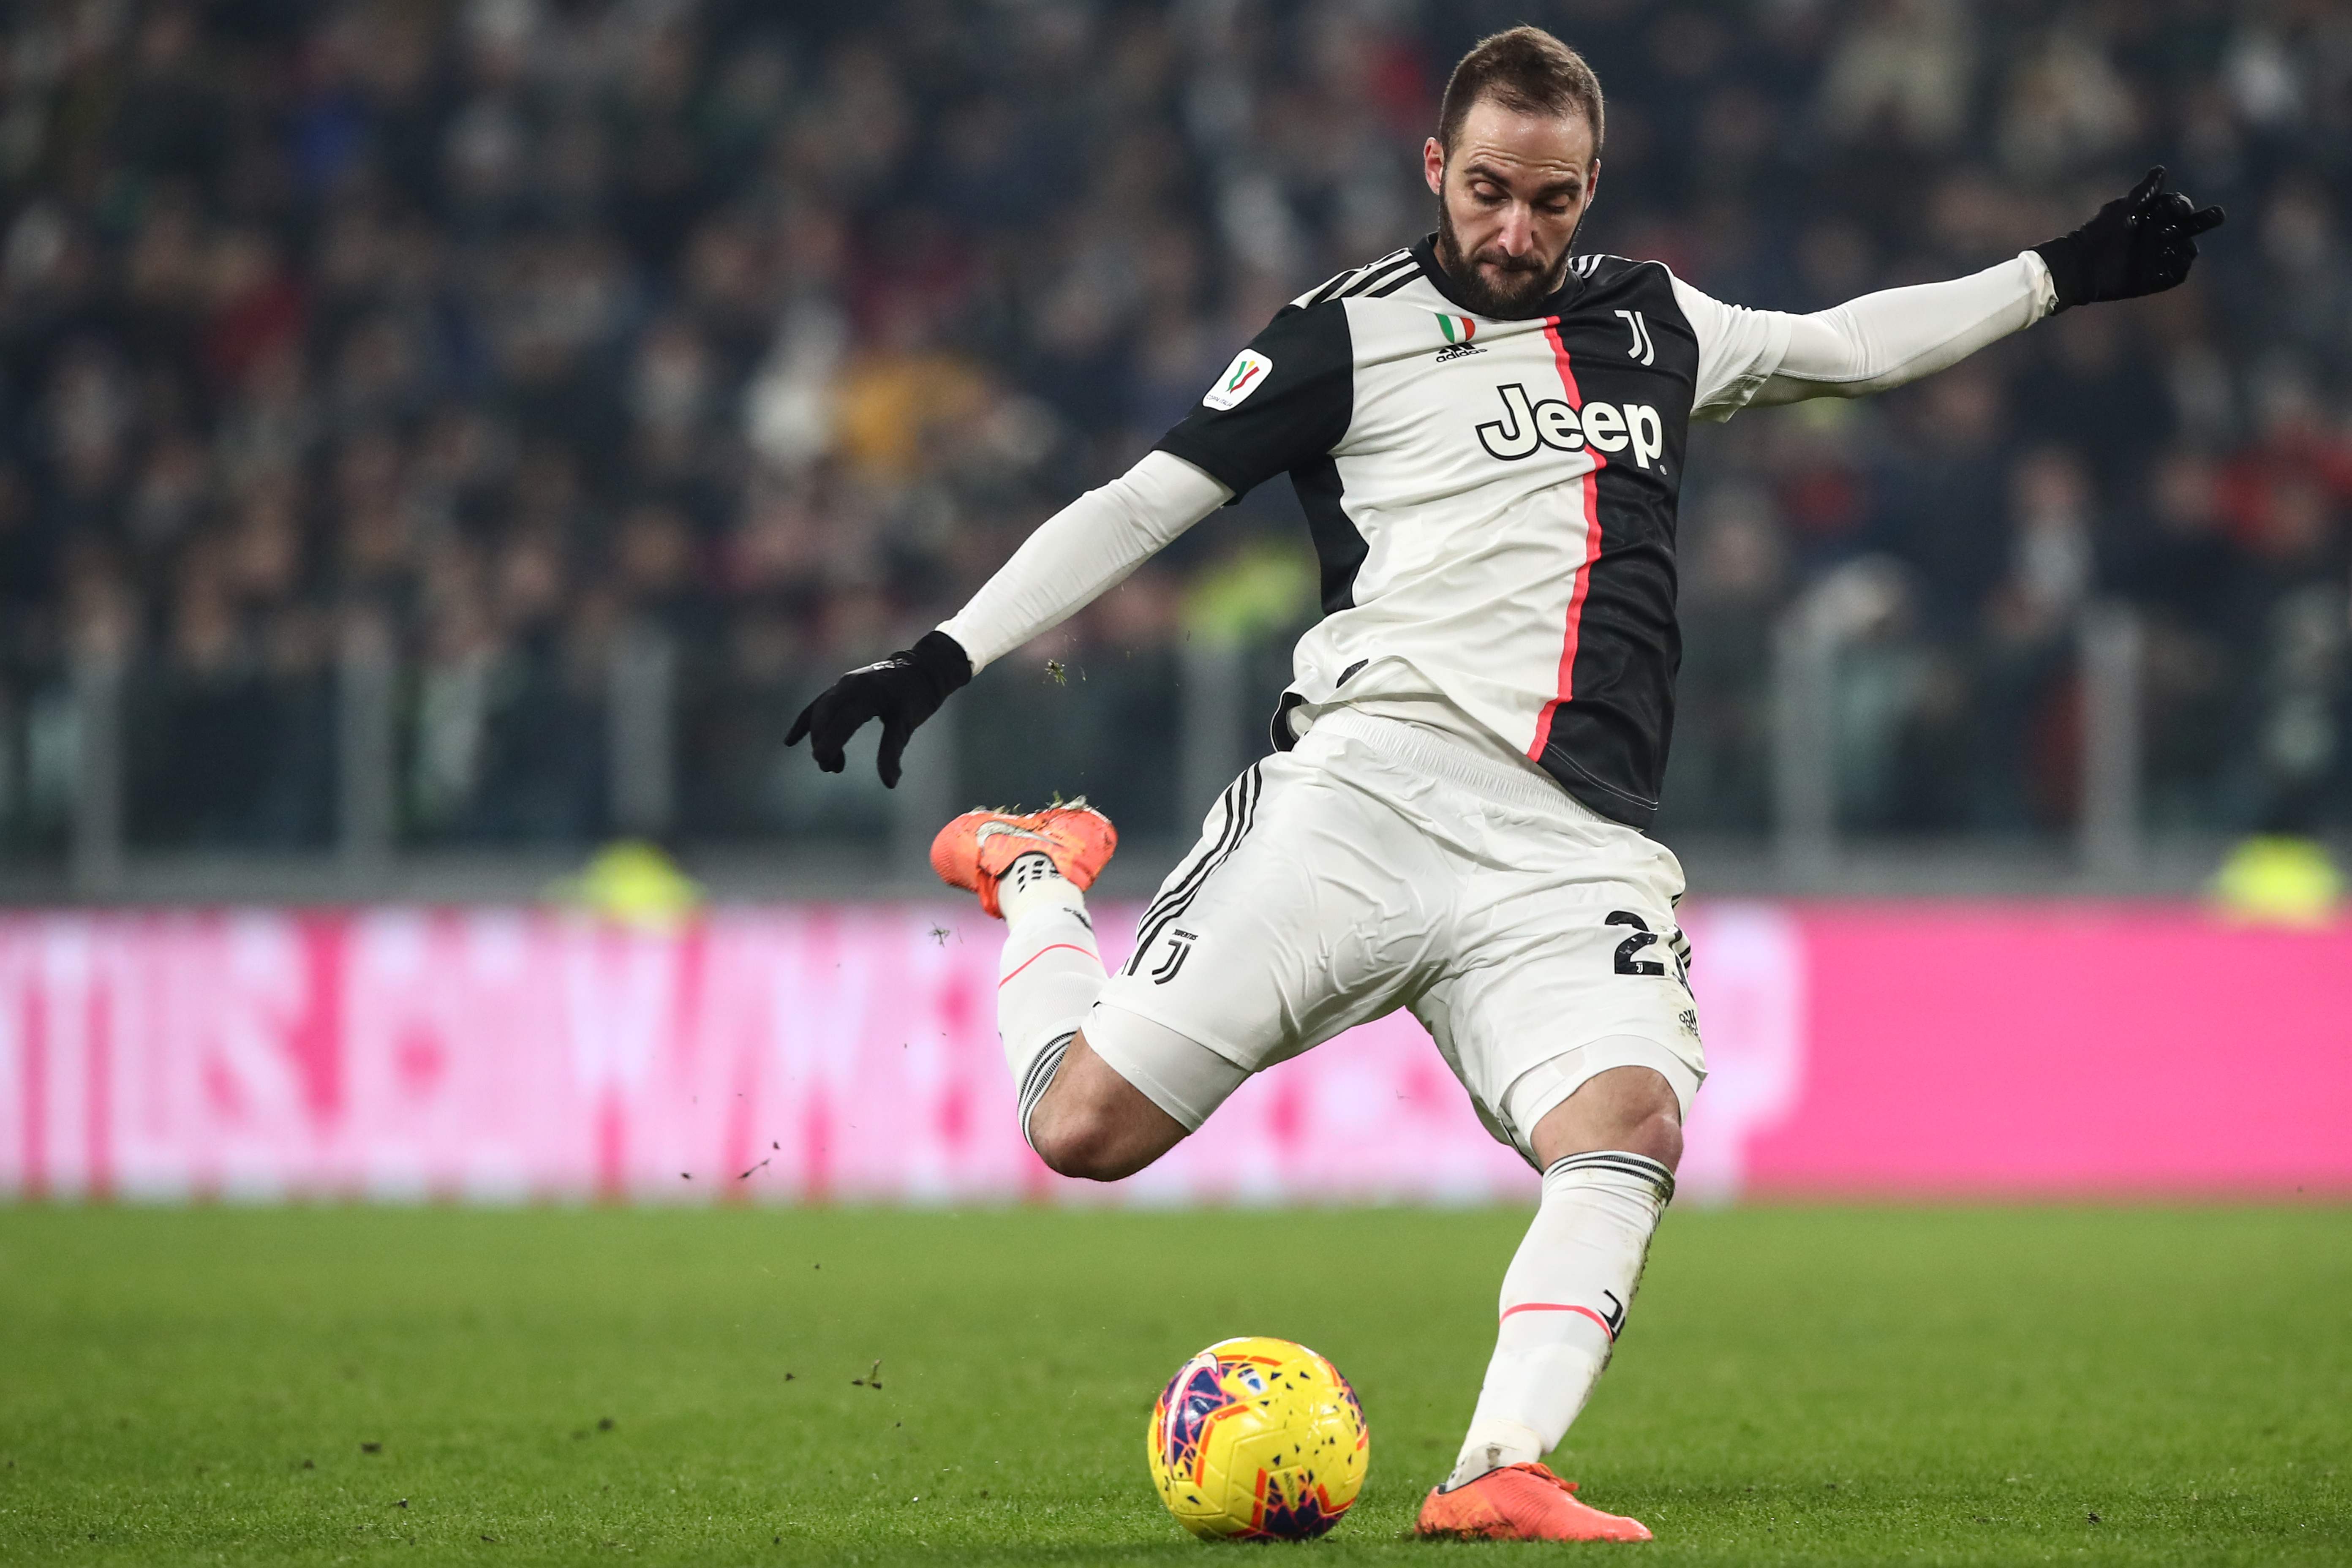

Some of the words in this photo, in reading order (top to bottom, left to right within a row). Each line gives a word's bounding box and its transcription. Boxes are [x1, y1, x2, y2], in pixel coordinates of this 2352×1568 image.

[1436, 348, 1488, 362] adidas
[1475, 383, 1663, 469] Jeep
[1172, 928, 1198, 940] JUVENTUS
